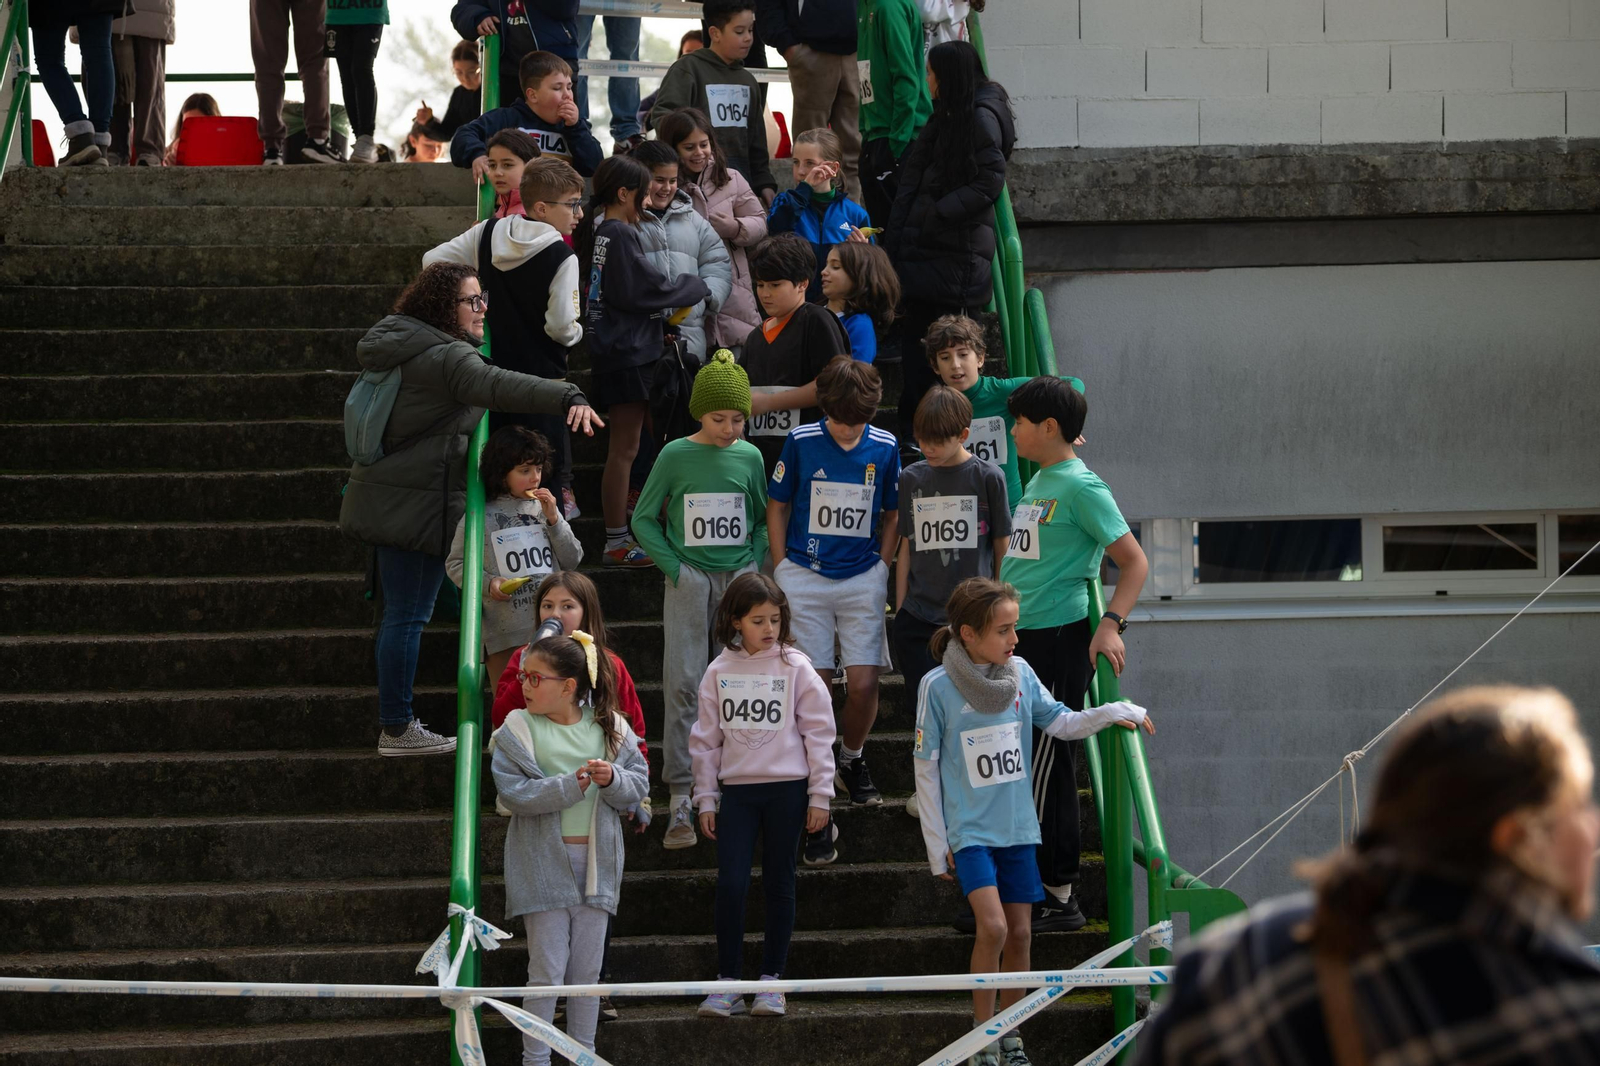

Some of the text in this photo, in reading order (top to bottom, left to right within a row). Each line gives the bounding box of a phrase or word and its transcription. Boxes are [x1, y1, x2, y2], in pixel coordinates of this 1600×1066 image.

[716, 102, 748, 121] 0164
[753, 410, 792, 430] 0163
[963, 439, 999, 462] 161
[692, 516, 742, 540] 0166
[817, 505, 867, 530] 0167
[921, 519, 969, 544] 0169
[505, 546, 552, 573] 0106
[513, 580, 541, 596] HERE
[513, 596, 536, 610] FINI
[722, 698, 782, 724] 0496
[976, 748, 1022, 779] 0162
[1008, 994, 1048, 1024] DEPORTE
